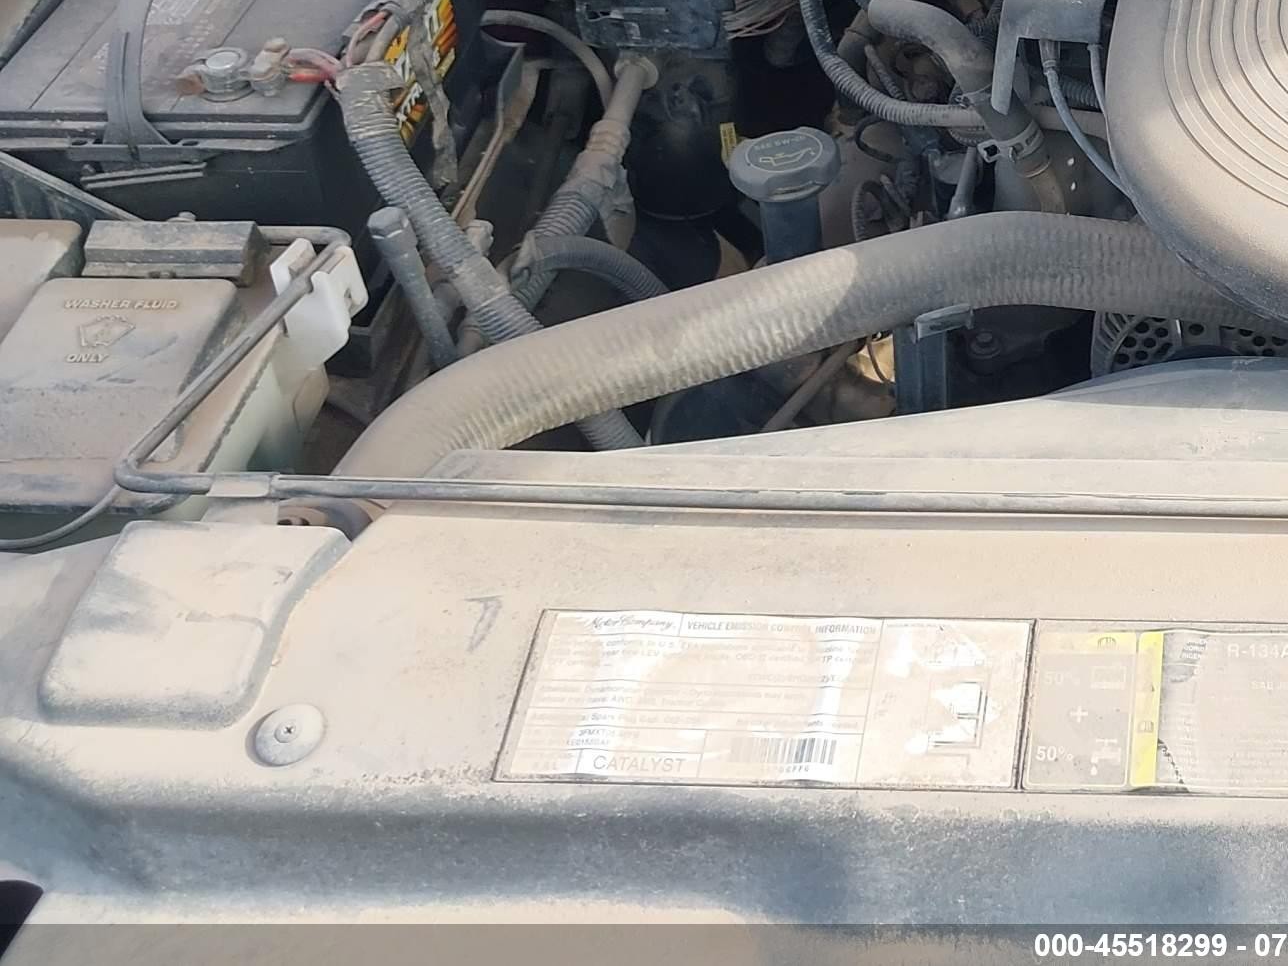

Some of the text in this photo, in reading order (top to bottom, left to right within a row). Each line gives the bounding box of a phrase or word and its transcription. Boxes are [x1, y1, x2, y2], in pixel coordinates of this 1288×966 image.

[63, 297, 178, 311] WASHER FLUID
[65, 352, 110, 365] ONLY
[687, 620, 724, 631] VEHICLE
[814, 623, 876, 635] INFORMATION
[1035, 745, 1075, 762] 50%
[592, 754, 687, 773] CATALYST
